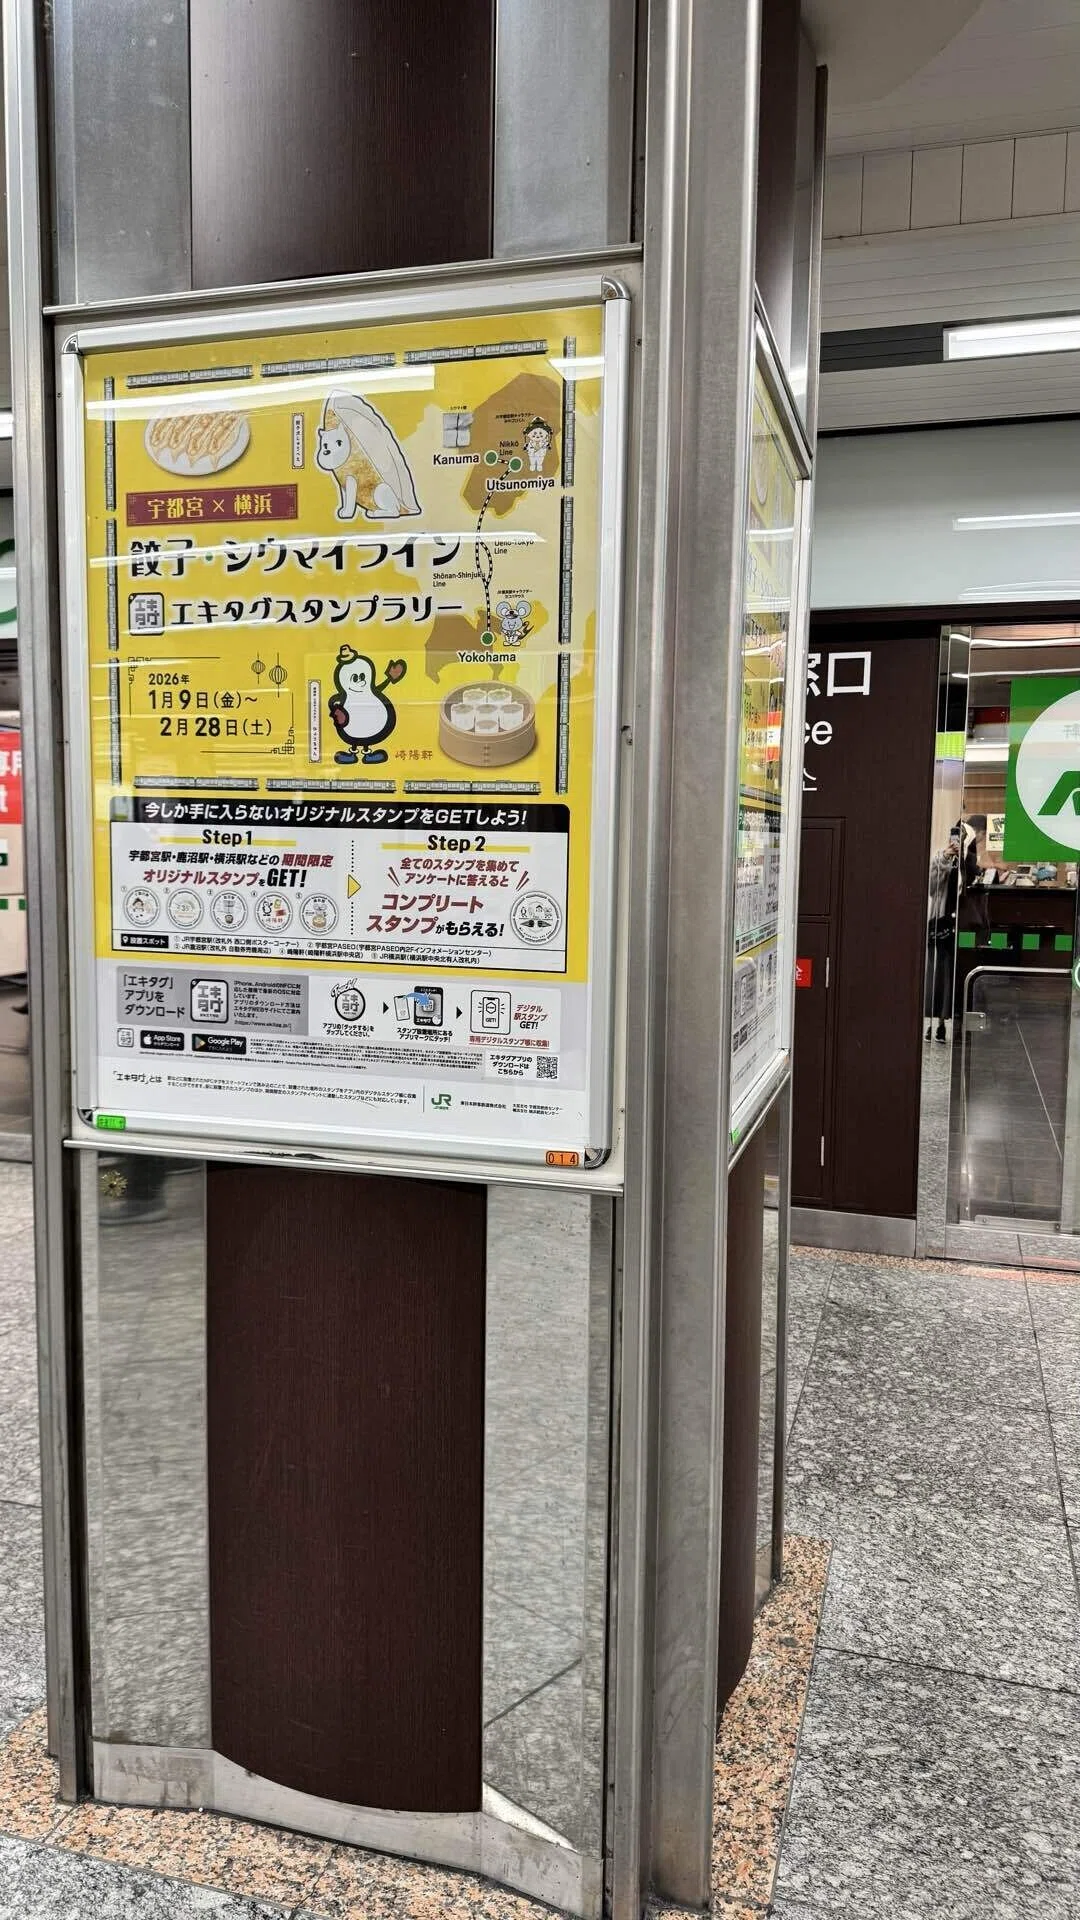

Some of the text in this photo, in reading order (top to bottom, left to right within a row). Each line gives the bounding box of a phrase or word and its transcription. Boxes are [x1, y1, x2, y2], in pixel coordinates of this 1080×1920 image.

[433, 454, 479, 465] Kanuma
[487, 477, 555, 491] Utsunomiya
[147, 496, 204, 520] 宇都宮
[234, 493, 272, 516] 横浜
[171, 595, 462, 625] エキタグスタンプラリー
[458, 651, 516, 663] Yokohama
[149, 673, 190, 685] 2026年
[145, 802, 527, 825] 今しか手に入らないオリジナルスタンプをGETしよう!
[400, 857, 520, 873] 全てのスタンプを集めて
[404, 872, 509, 888] アンケートに答えると
[382, 893, 484, 914] コンプリート
[366, 915, 505, 938] スタンプがもらえる!
[130, 938, 166, 946] 設置スポット
[123, 974, 173, 990] 「エキタグ」
[125, 990, 165, 1003] アプリを
[124, 1004, 185, 1019] ダウンロード
[516, 1004, 543, 1013] デジタル
[514, 1013, 548, 1021] 駅スタンプ
[520, 1021, 539, 1030] GET!
[208, 1037, 244, 1047] Google Play
[490, 1054, 532, 1063] エキタグアプリの
[492, 1061, 529, 1069] ダウンロードは
[431, 1093, 452, 1106] JR
